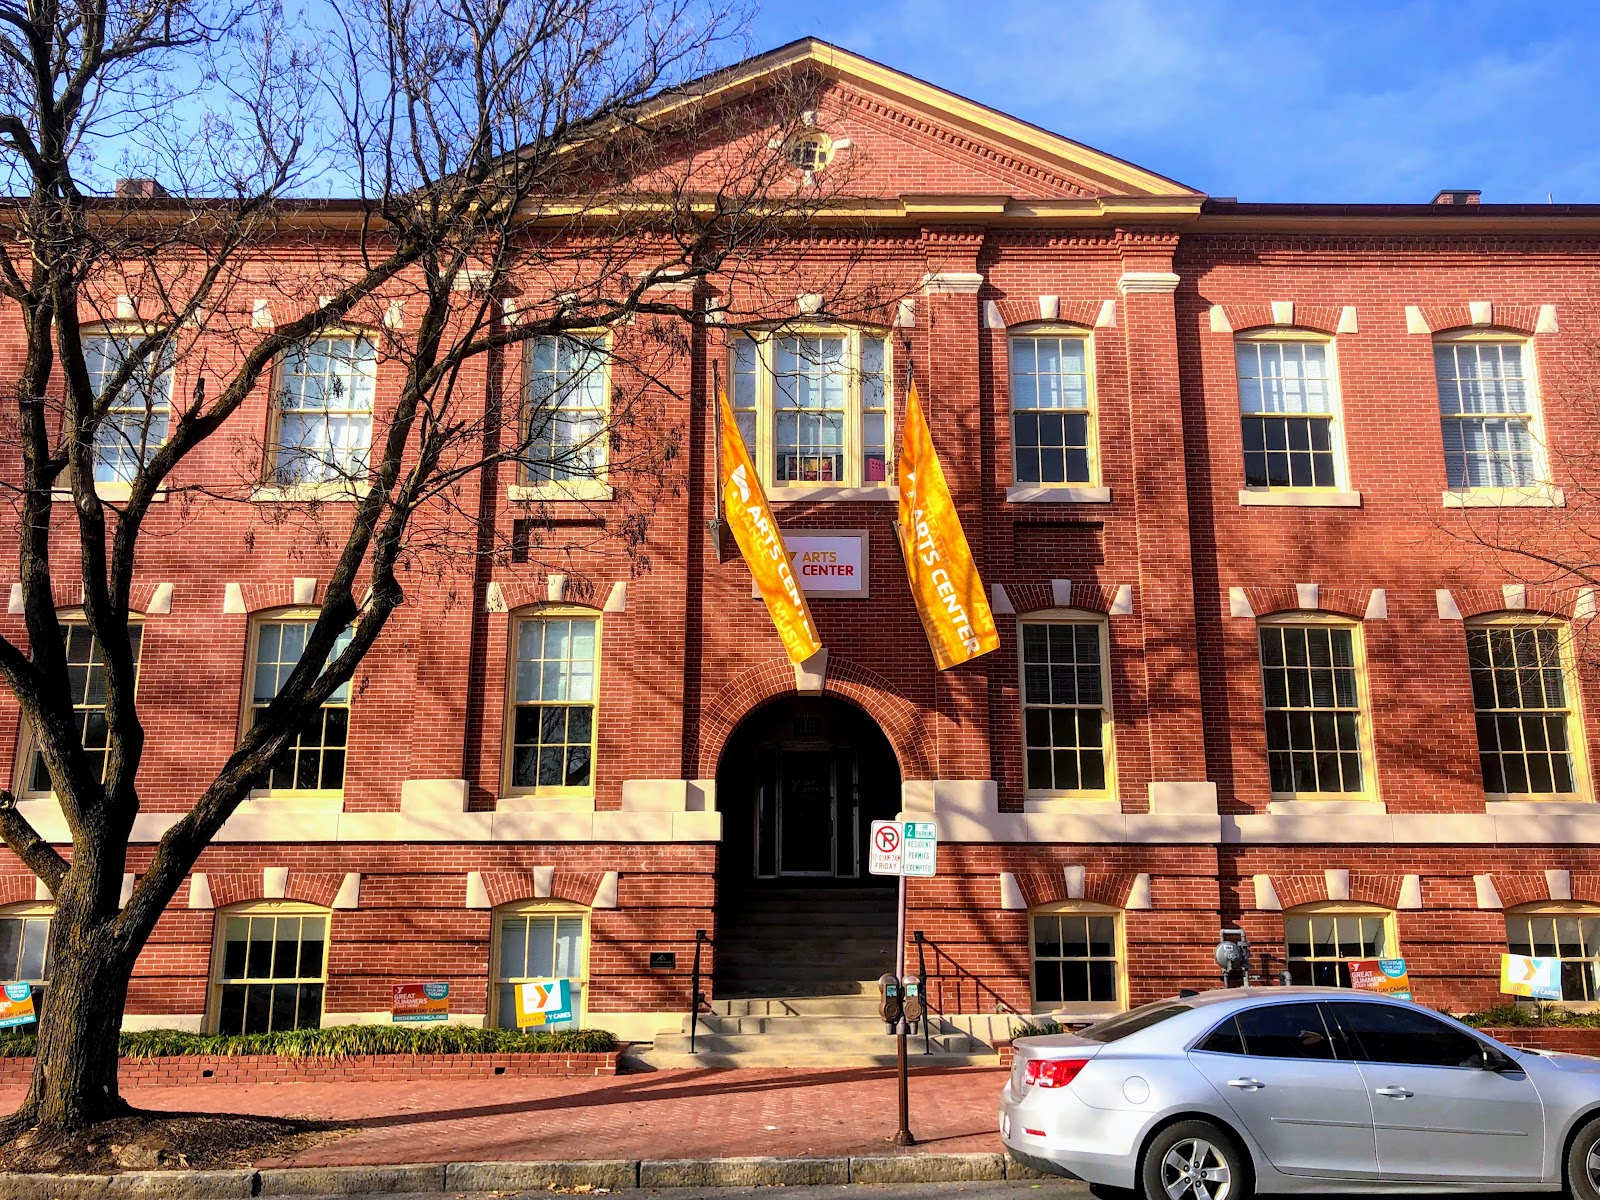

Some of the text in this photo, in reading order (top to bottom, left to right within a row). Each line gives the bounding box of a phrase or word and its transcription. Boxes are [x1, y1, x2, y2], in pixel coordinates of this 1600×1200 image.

[802, 551, 837, 563] ARTS
[802, 564, 854, 576] CENTER
[746, 506, 782, 561] ARTS
[777, 562, 819, 649] CEN
[913, 510, 980, 656] ARTS CENTER
[773, 600, 807, 656] MUSIC
[907, 824, 912, 836] 2
